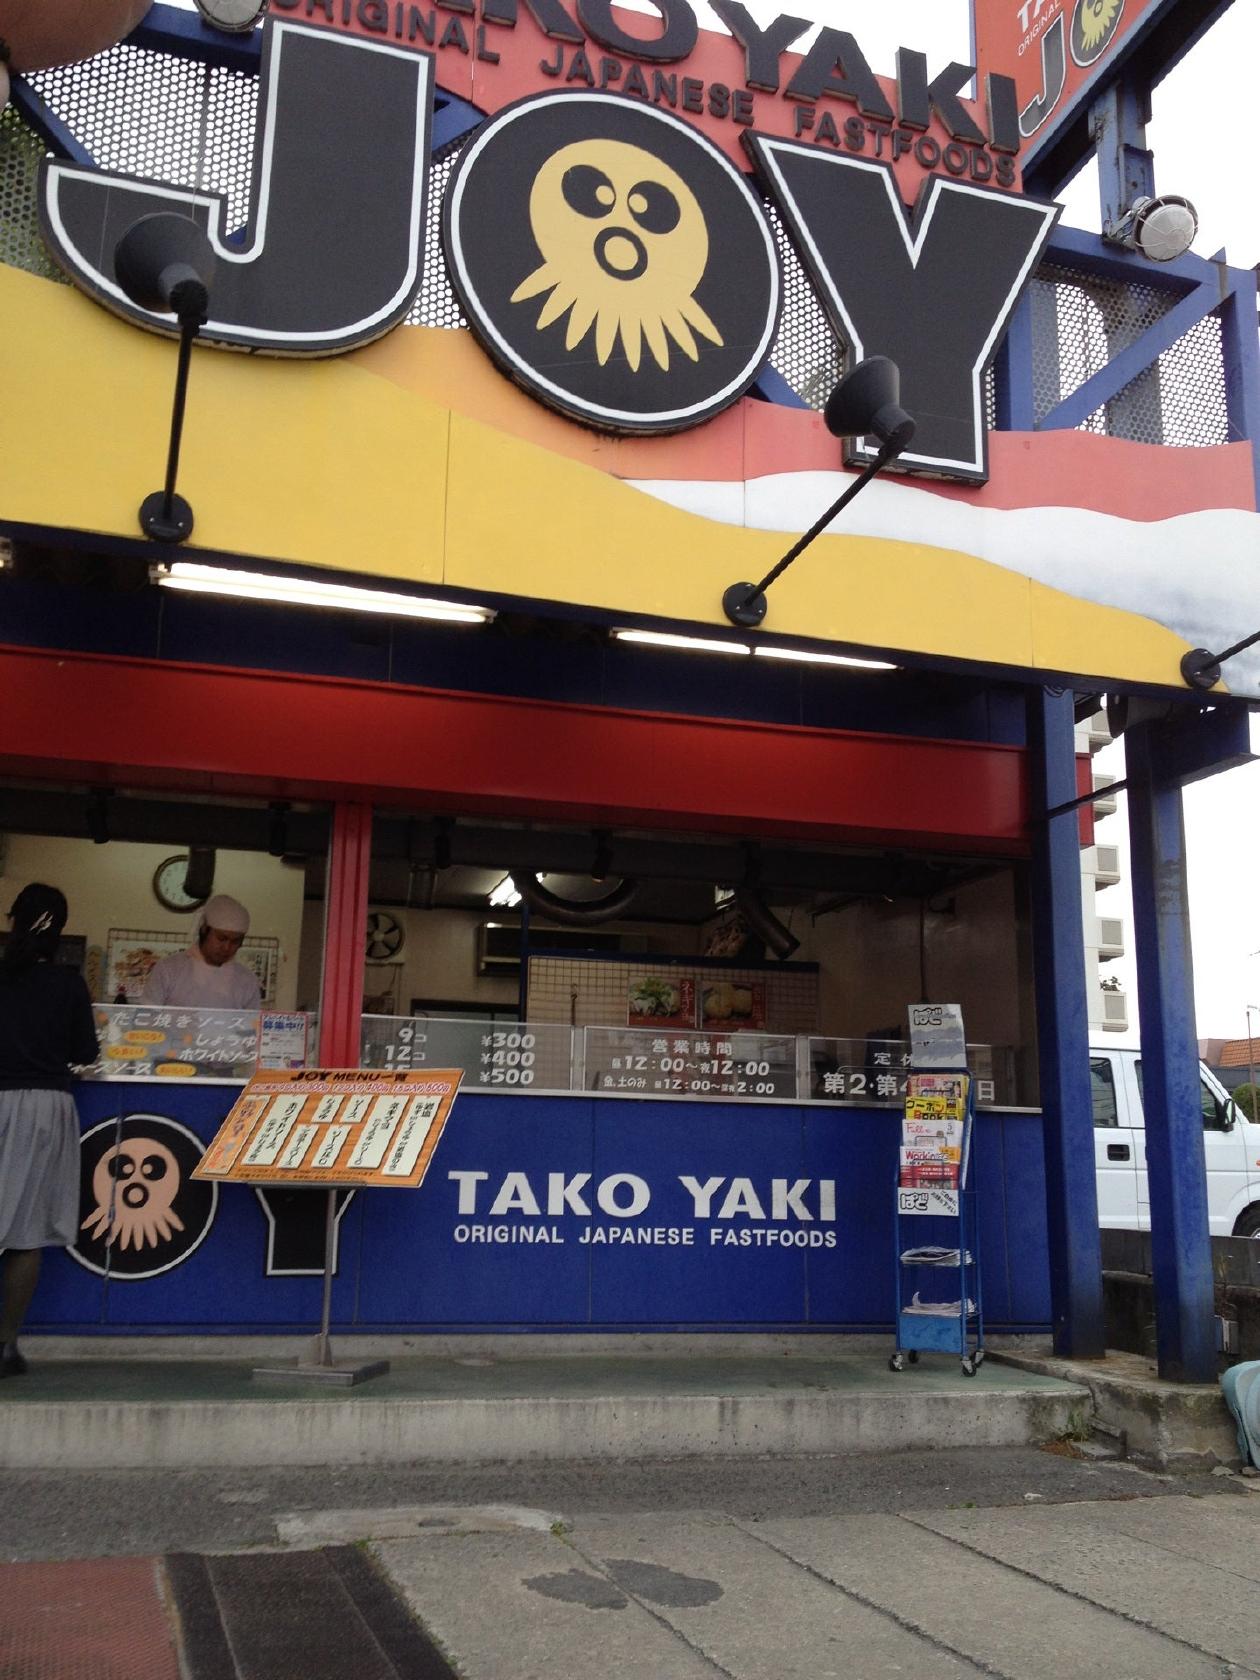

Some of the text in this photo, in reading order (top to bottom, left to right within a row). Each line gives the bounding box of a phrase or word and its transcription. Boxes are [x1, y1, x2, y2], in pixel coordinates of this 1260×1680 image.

[706, 0, 1019, 153] YAKI
[268, 0, 500, 65] RIGINAL
[539, 43, 755, 126] JAPANESE
[793, 106, 1016, 188] FASTFOODS
[111, 1012, 246, 1029] たこ焼きソース
[480, 1032, 535, 1049] ¥300
[652, 1039, 733, 1056] 営業時間
[385, 1045, 535, 1067] 12コ ¥400
[291, 1071, 332, 1081] JOY
[480, 1068, 535, 1085] ¥500
[448, 1170, 837, 1221] TAKO YAKI
[454, 1225, 838, 1249] ORIGINAL JAPANESE FASTFOODS
